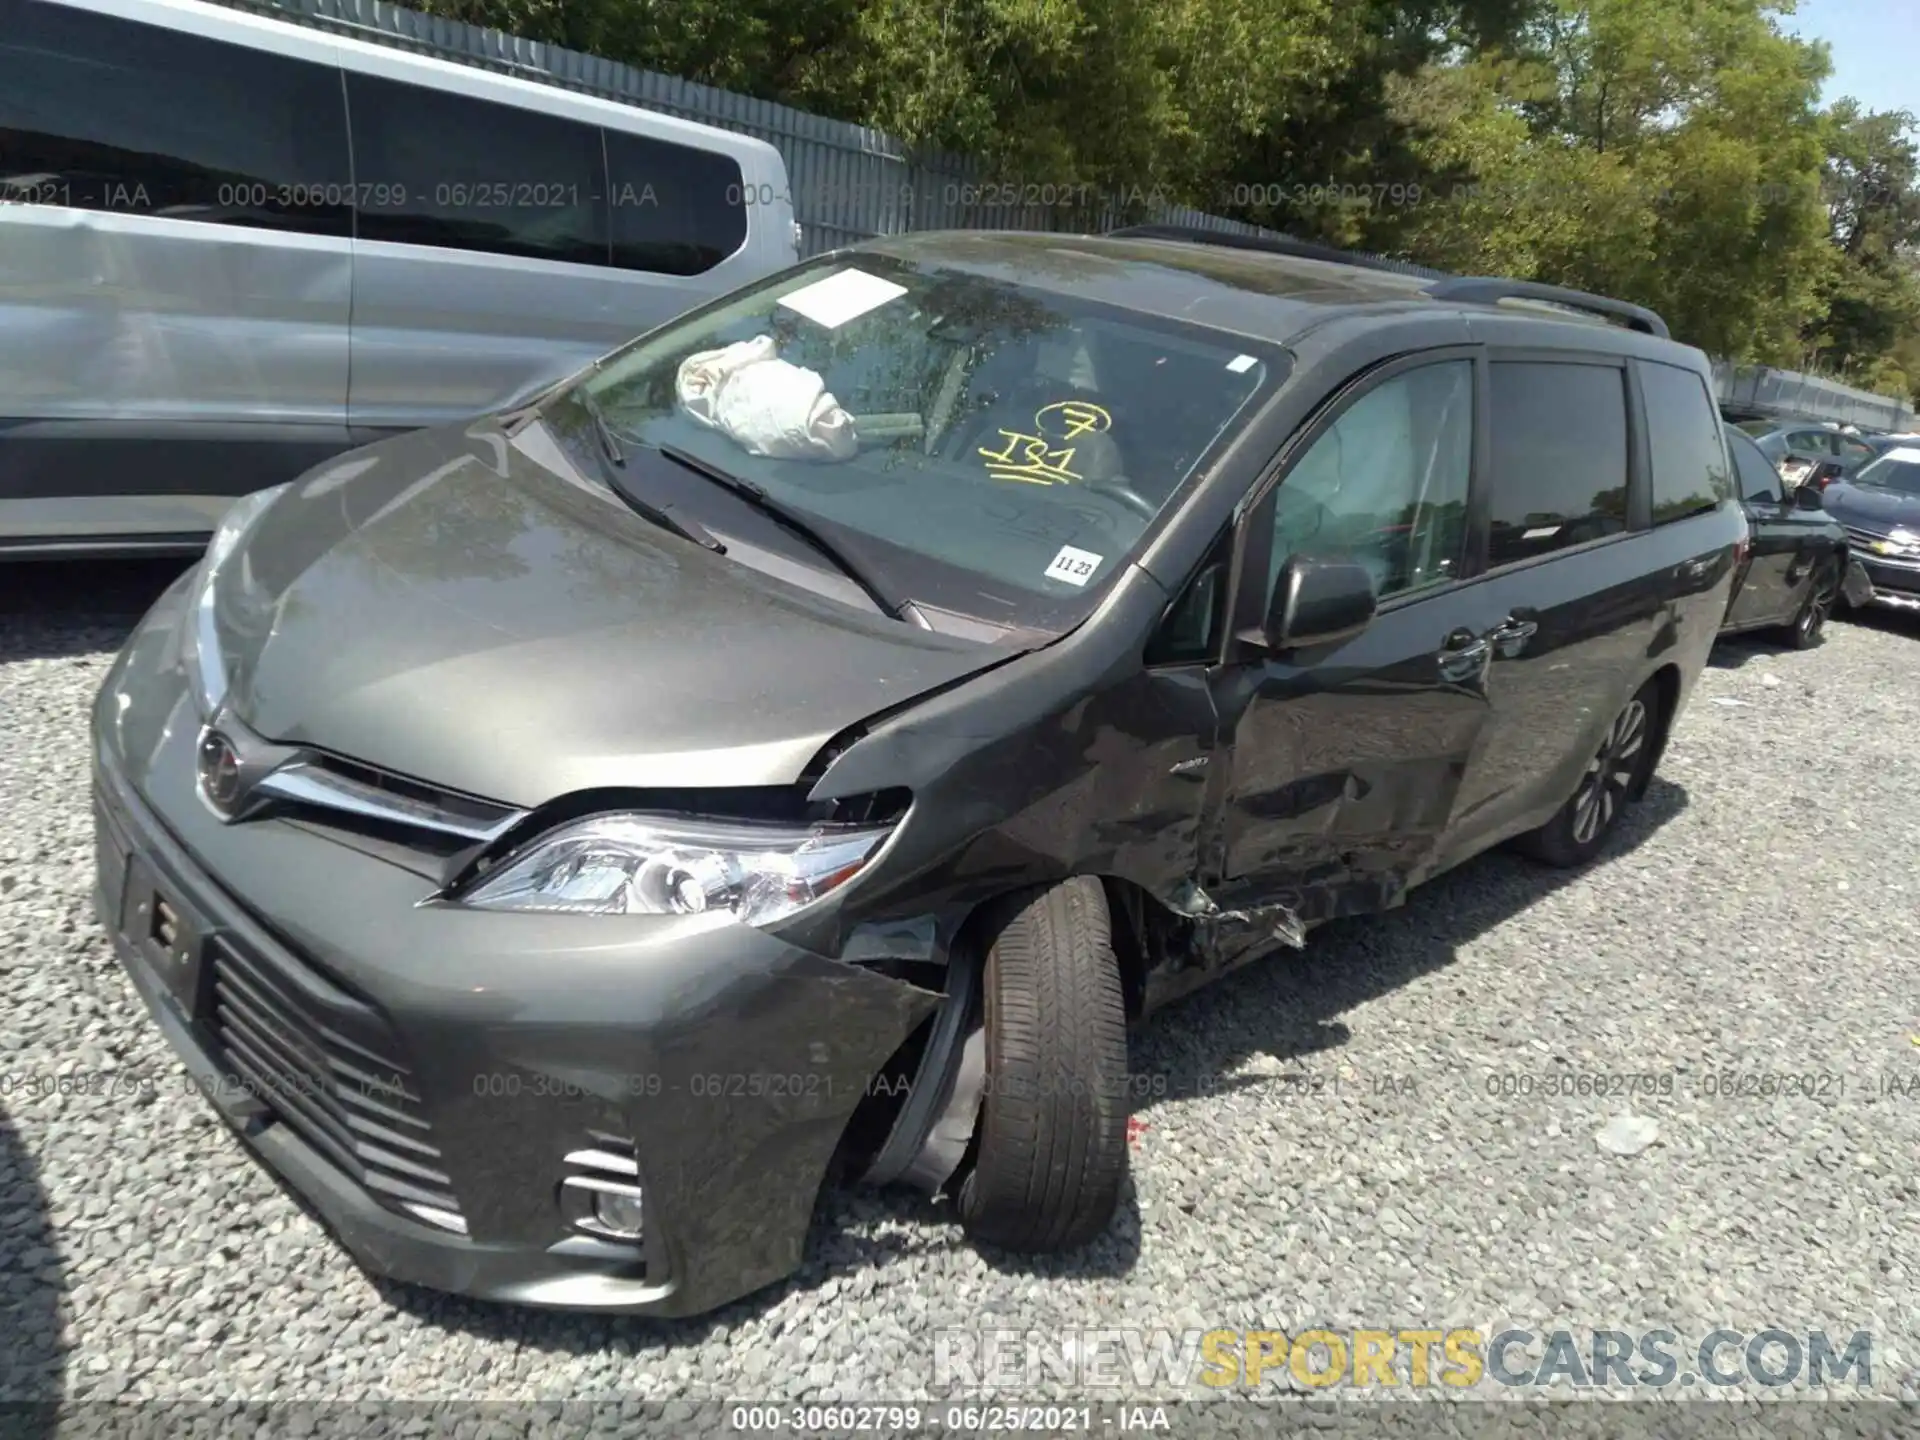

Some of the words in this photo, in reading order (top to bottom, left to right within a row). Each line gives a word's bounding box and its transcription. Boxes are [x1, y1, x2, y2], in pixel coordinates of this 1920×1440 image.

[1062, 407, 1098, 440] 7
[1056, 556, 1074, 571] 11
[1073, 561, 1092, 576] 23
